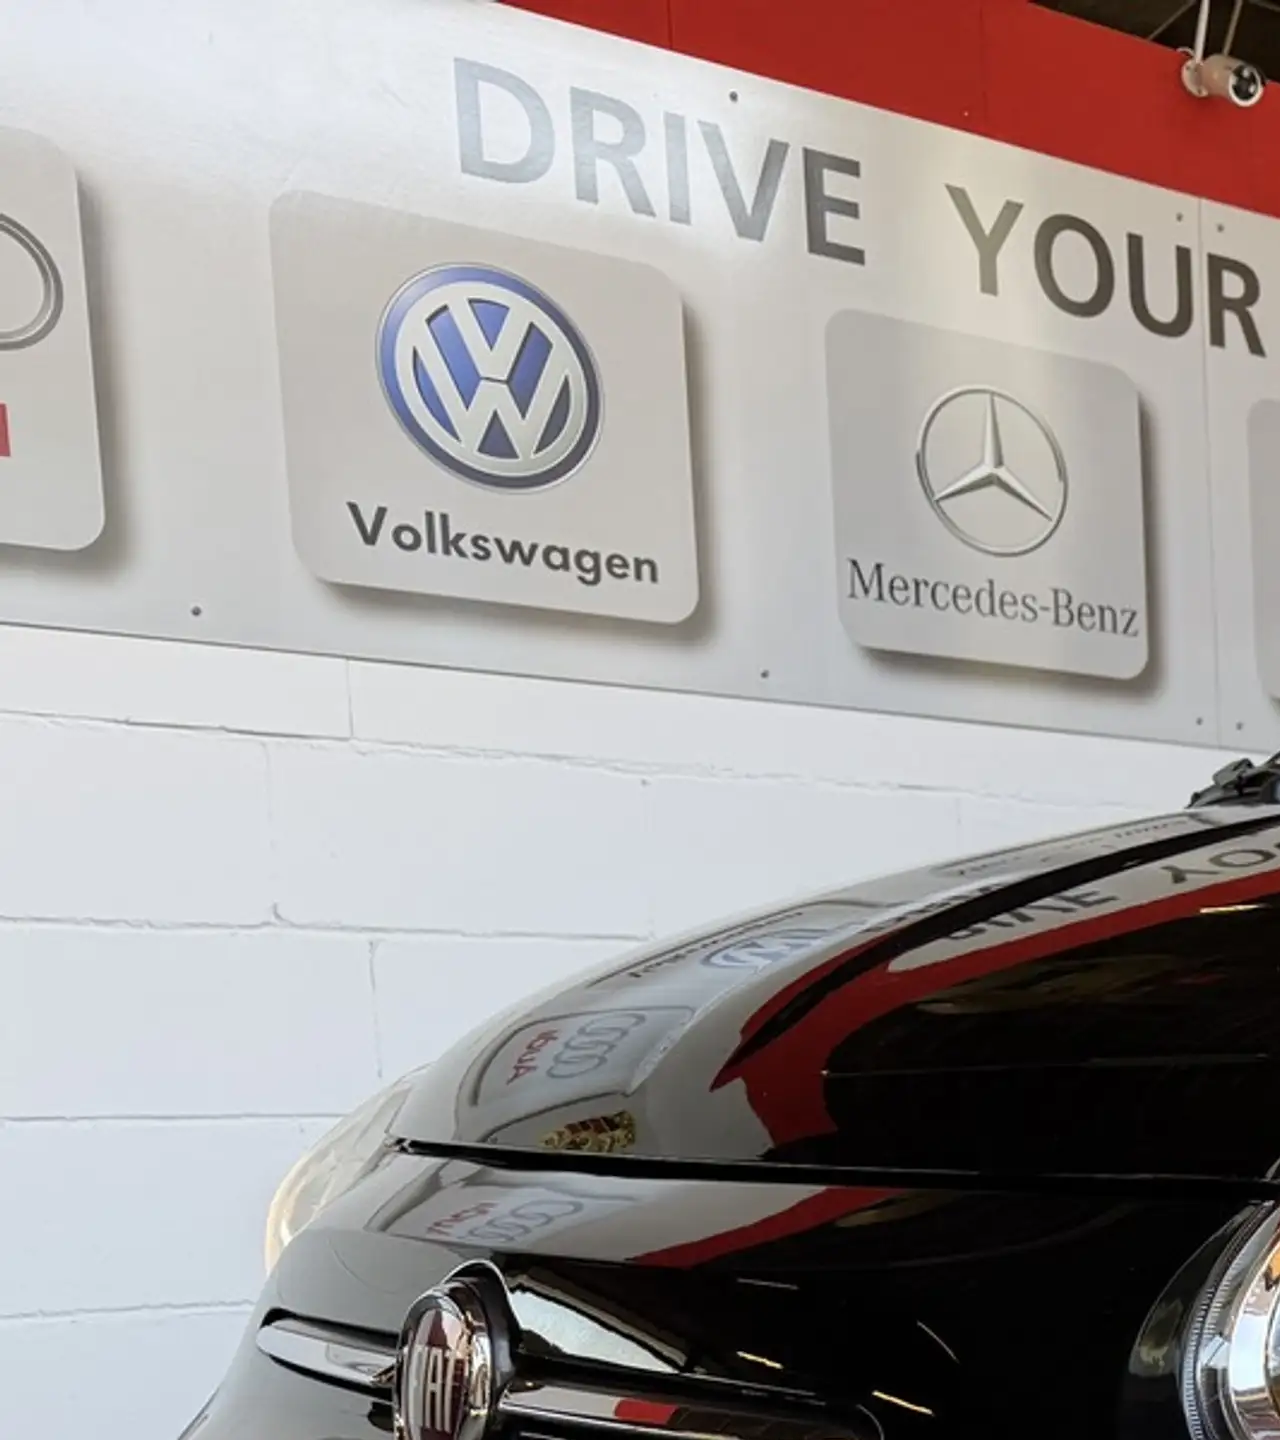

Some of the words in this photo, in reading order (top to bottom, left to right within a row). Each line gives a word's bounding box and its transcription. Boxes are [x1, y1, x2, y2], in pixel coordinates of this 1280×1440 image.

[453, 57, 867, 267] DRIVE
[943, 182, 1267, 360] YOUR
[346, 500, 660, 587] Volkswagen
[847, 558, 1140, 640] Mercedes-Benz
